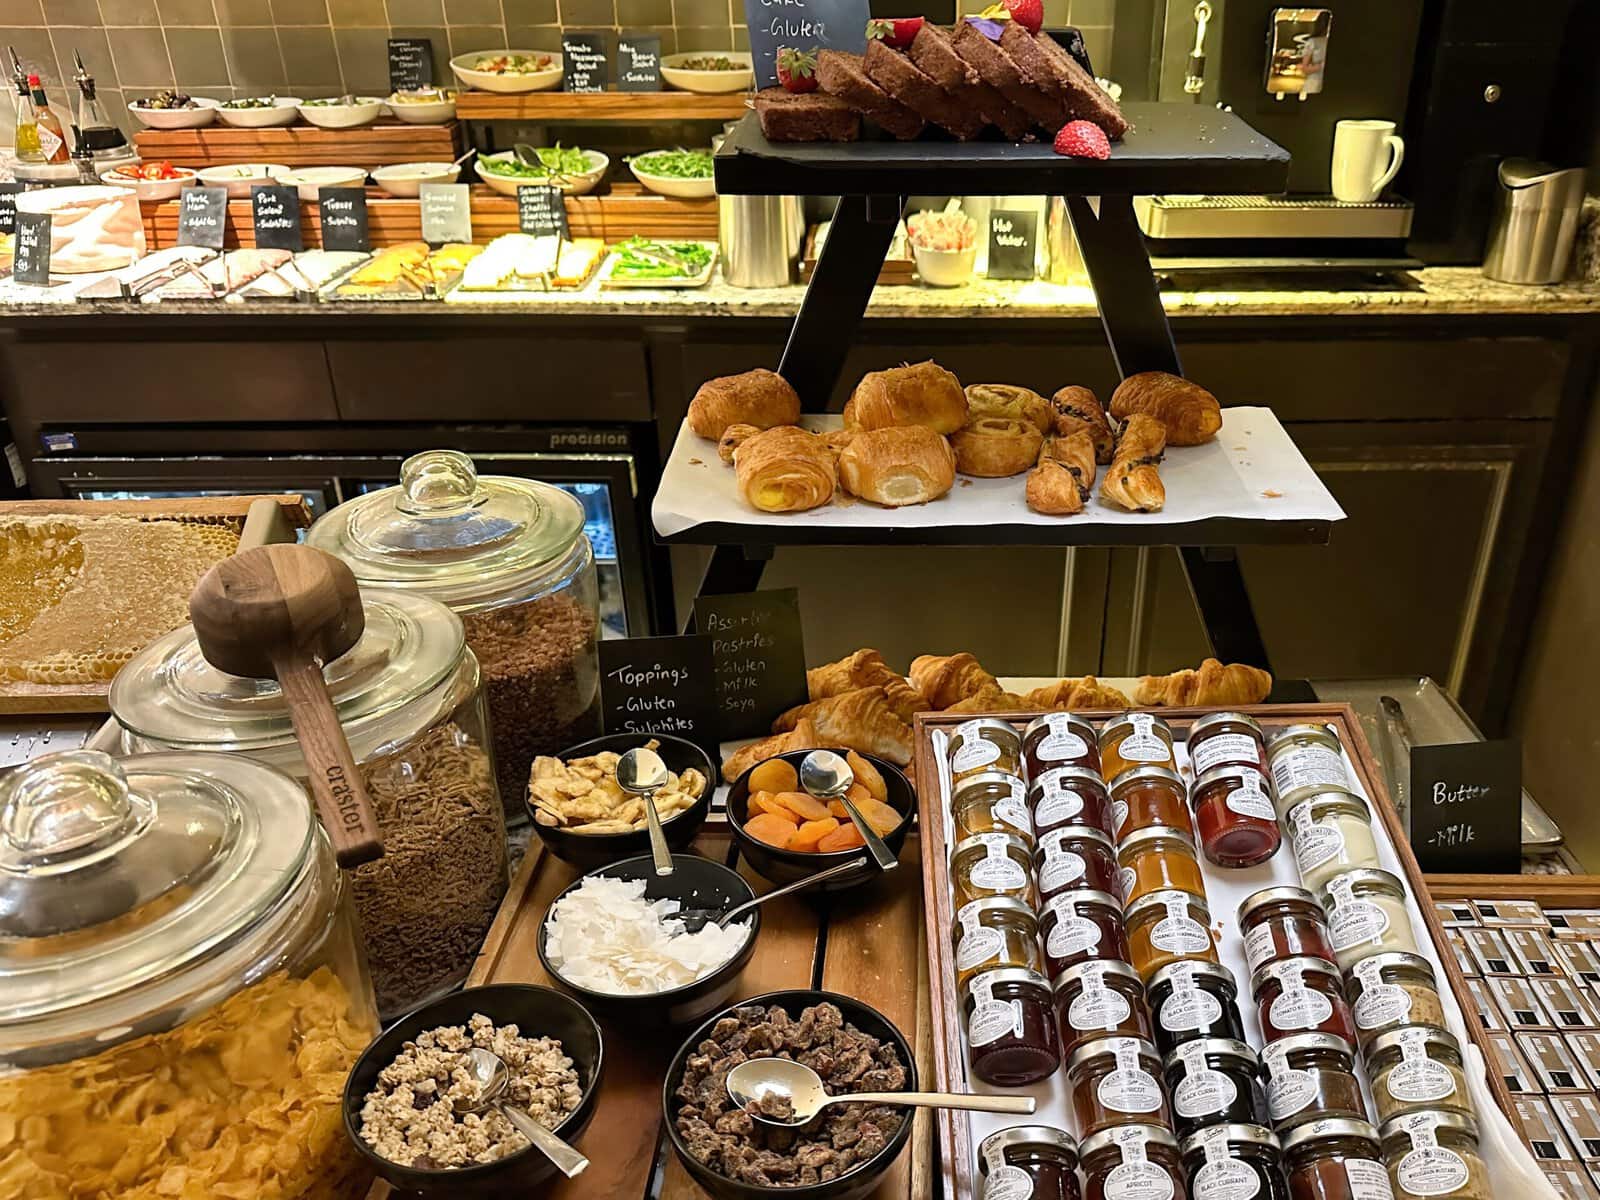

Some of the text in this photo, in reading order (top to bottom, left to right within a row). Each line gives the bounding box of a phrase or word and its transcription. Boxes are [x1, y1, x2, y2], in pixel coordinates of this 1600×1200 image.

[992, 218, 1013, 233] Hot
[550, 433, 627, 449] precision
[607, 663, 689, 688] Toppings
[326, 765, 365, 834] craster
[1432, 781, 1491, 805] Butter
[1086, 1004, 1107, 1013] APRIC
[1168, 1003, 1210, 1017] BLACK CURNT
[1197, 1087, 1220, 1096] CURRA
[1126, 1180, 1152, 1189] APRICOT
[1218, 1177, 1247, 1186] CURRANT
